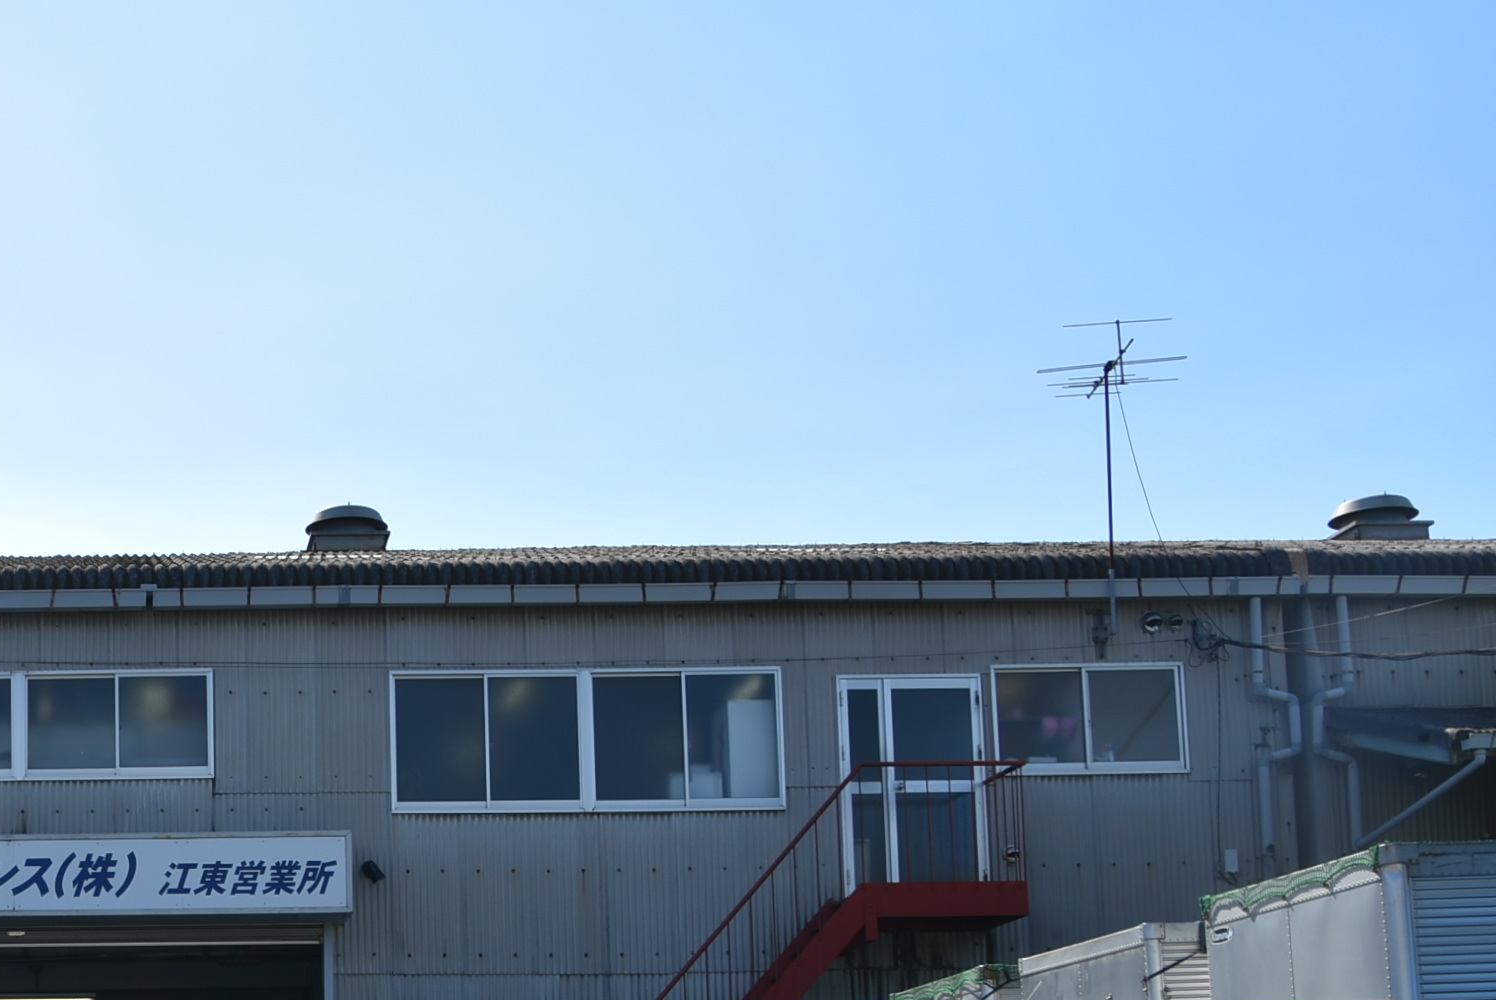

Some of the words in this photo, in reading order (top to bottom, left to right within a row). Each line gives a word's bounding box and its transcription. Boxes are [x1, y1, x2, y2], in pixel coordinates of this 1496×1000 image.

[158, 859, 338, 896] 江東営業所
